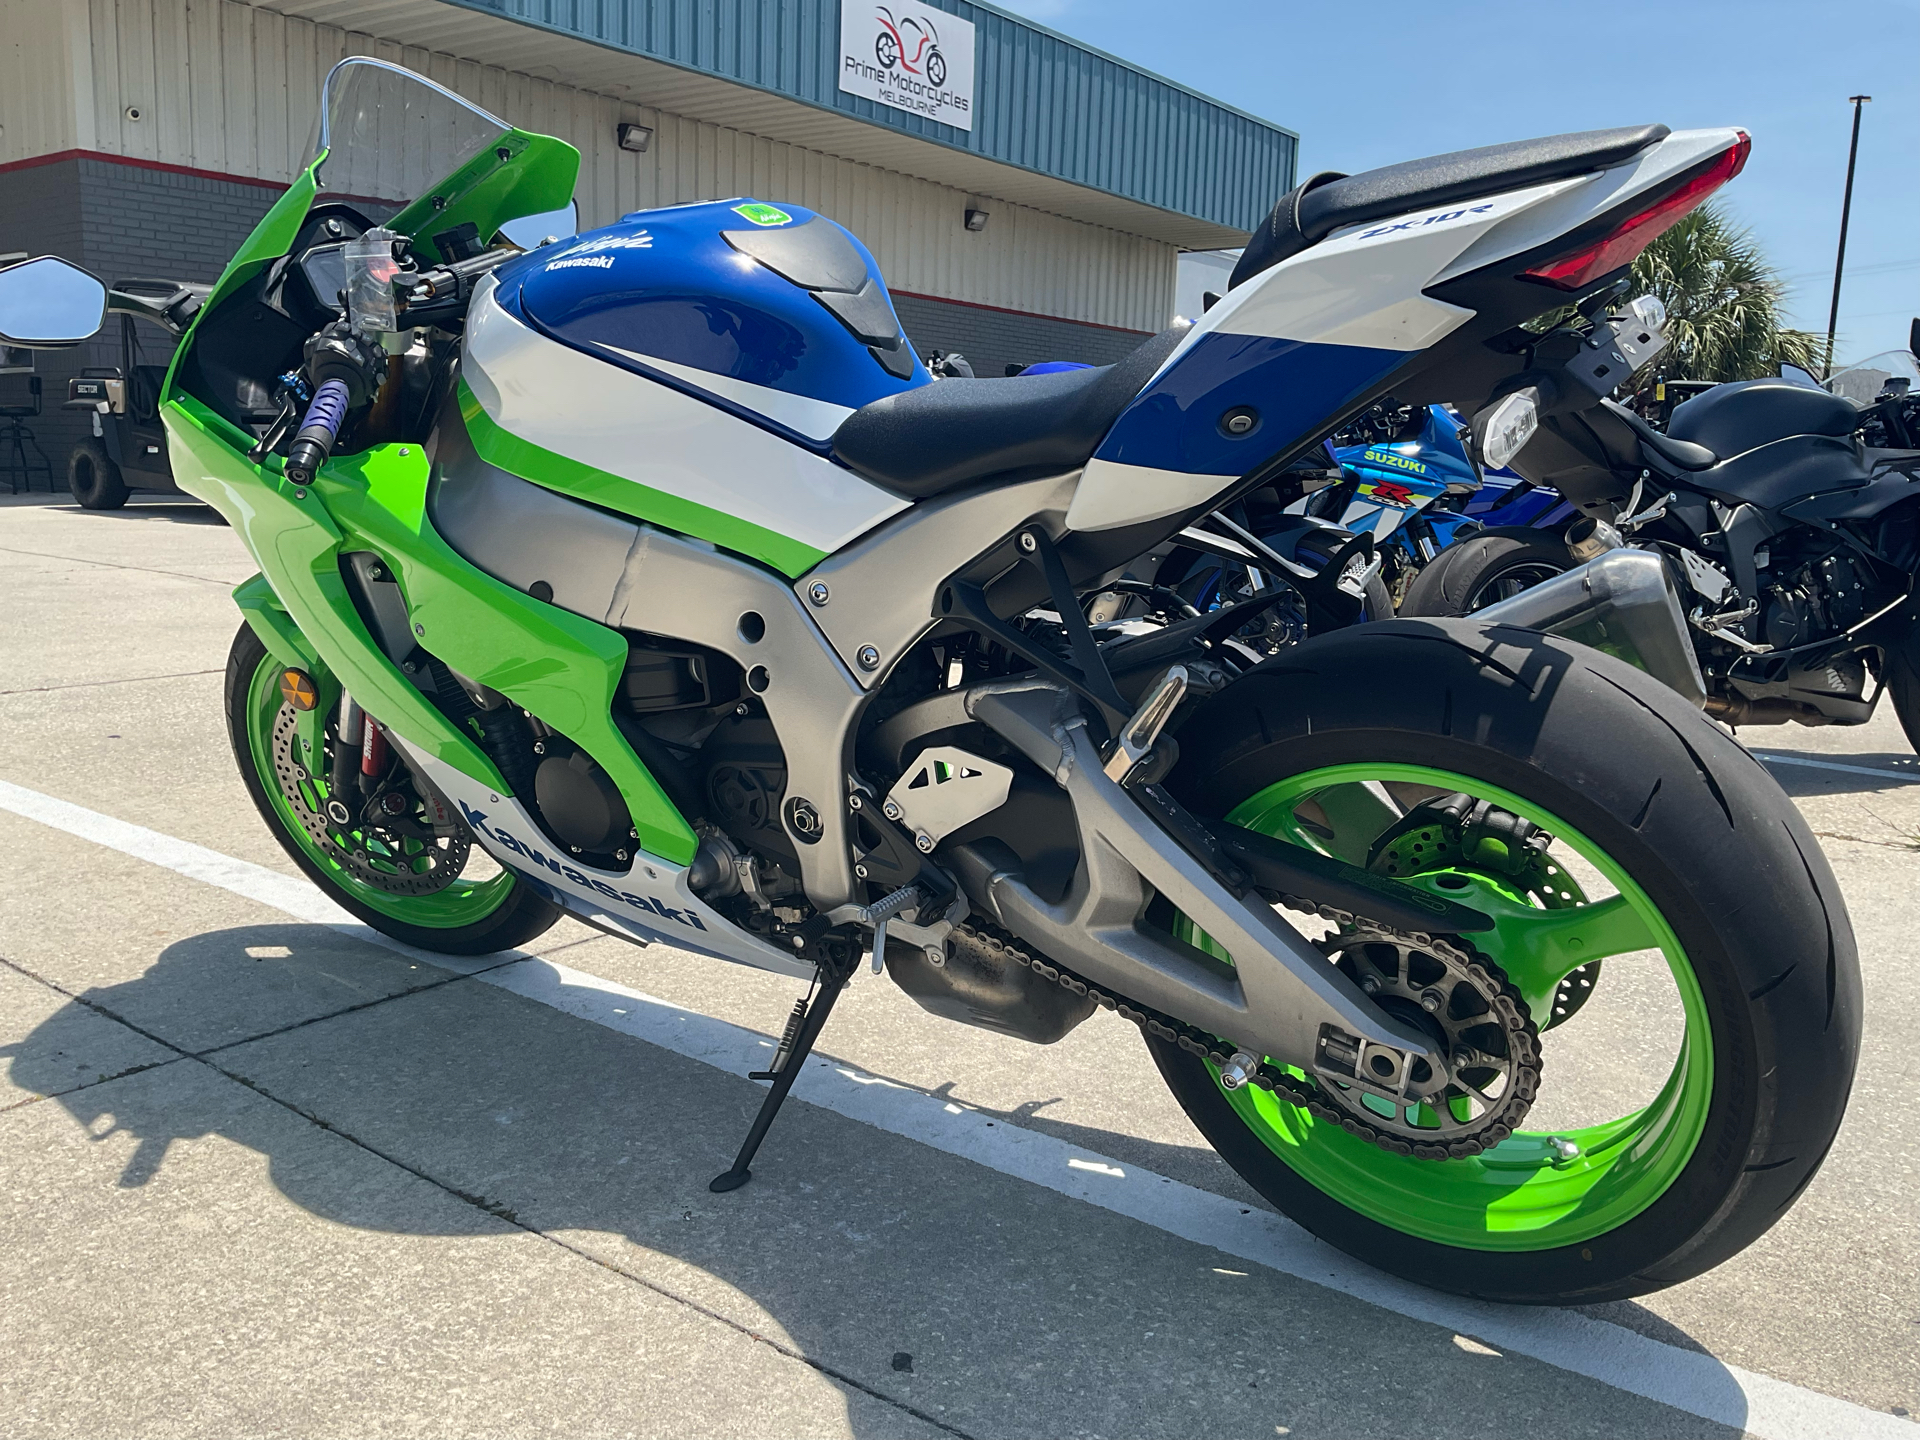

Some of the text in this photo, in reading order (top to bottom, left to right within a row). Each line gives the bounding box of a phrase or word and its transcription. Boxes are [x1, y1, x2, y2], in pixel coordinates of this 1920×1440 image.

[845, 55, 969, 111] Prime Motorcycles
[878, 88, 937, 116] MELBOURNE
[1359, 203, 1494, 240] ZX-10R
[545, 255, 615, 272] Kawasaki
[1363, 450, 1426, 474] SUZUKI
[363, 718, 374, 760] SHOWA
[458, 798, 709, 932] Kawasaki
